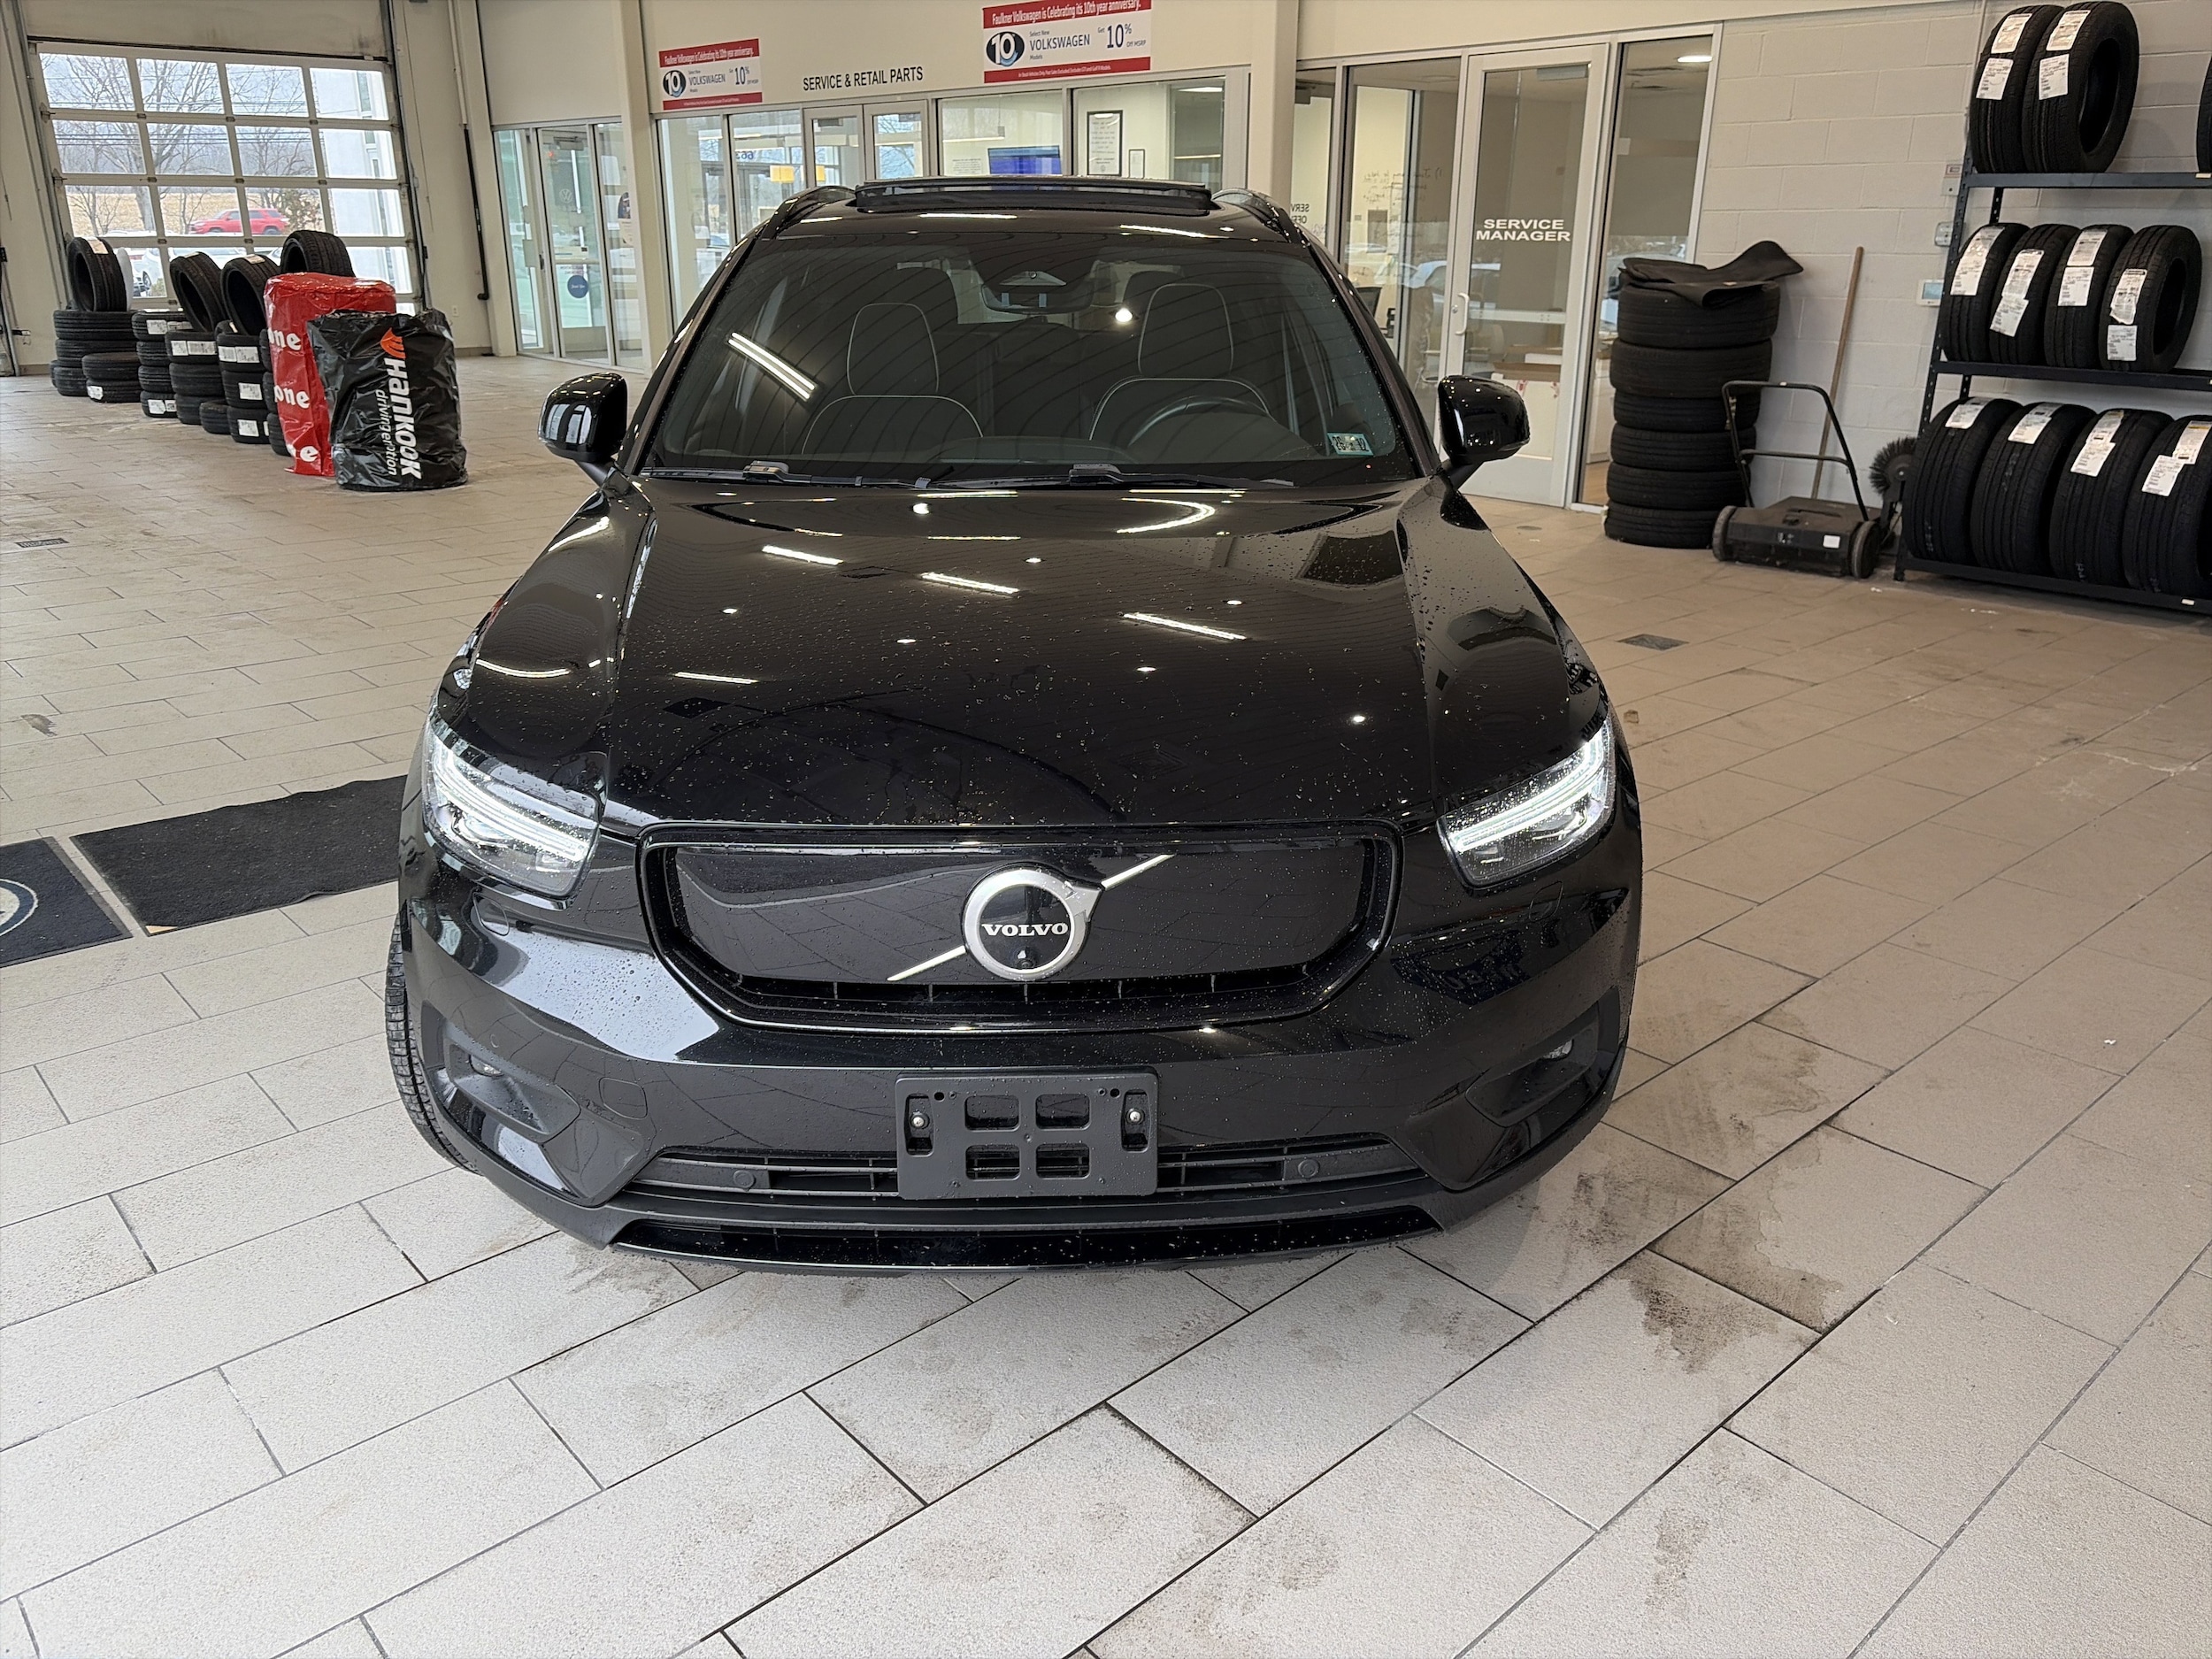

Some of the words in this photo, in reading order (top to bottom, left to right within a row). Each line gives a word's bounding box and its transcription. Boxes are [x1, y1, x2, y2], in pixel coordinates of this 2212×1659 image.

[1012, 10, 1041, 23] Volkswagen
[1096, 3, 1108, 15] year
[1029, 34, 1090, 51] VOLKSWAGEN
[688, 73, 726, 86] VOLKSWAGEN
[803, 74, 842, 91] SERVICE
[845, 73, 851, 88] &
[854, 70, 887, 87] RETAIL
[890, 66, 923, 83] PARTS
[1484, 219, 1564, 230] SERVICE
[1476, 230, 1571, 242] MANAGER
[981, 923, 1069, 936] VOLVO
